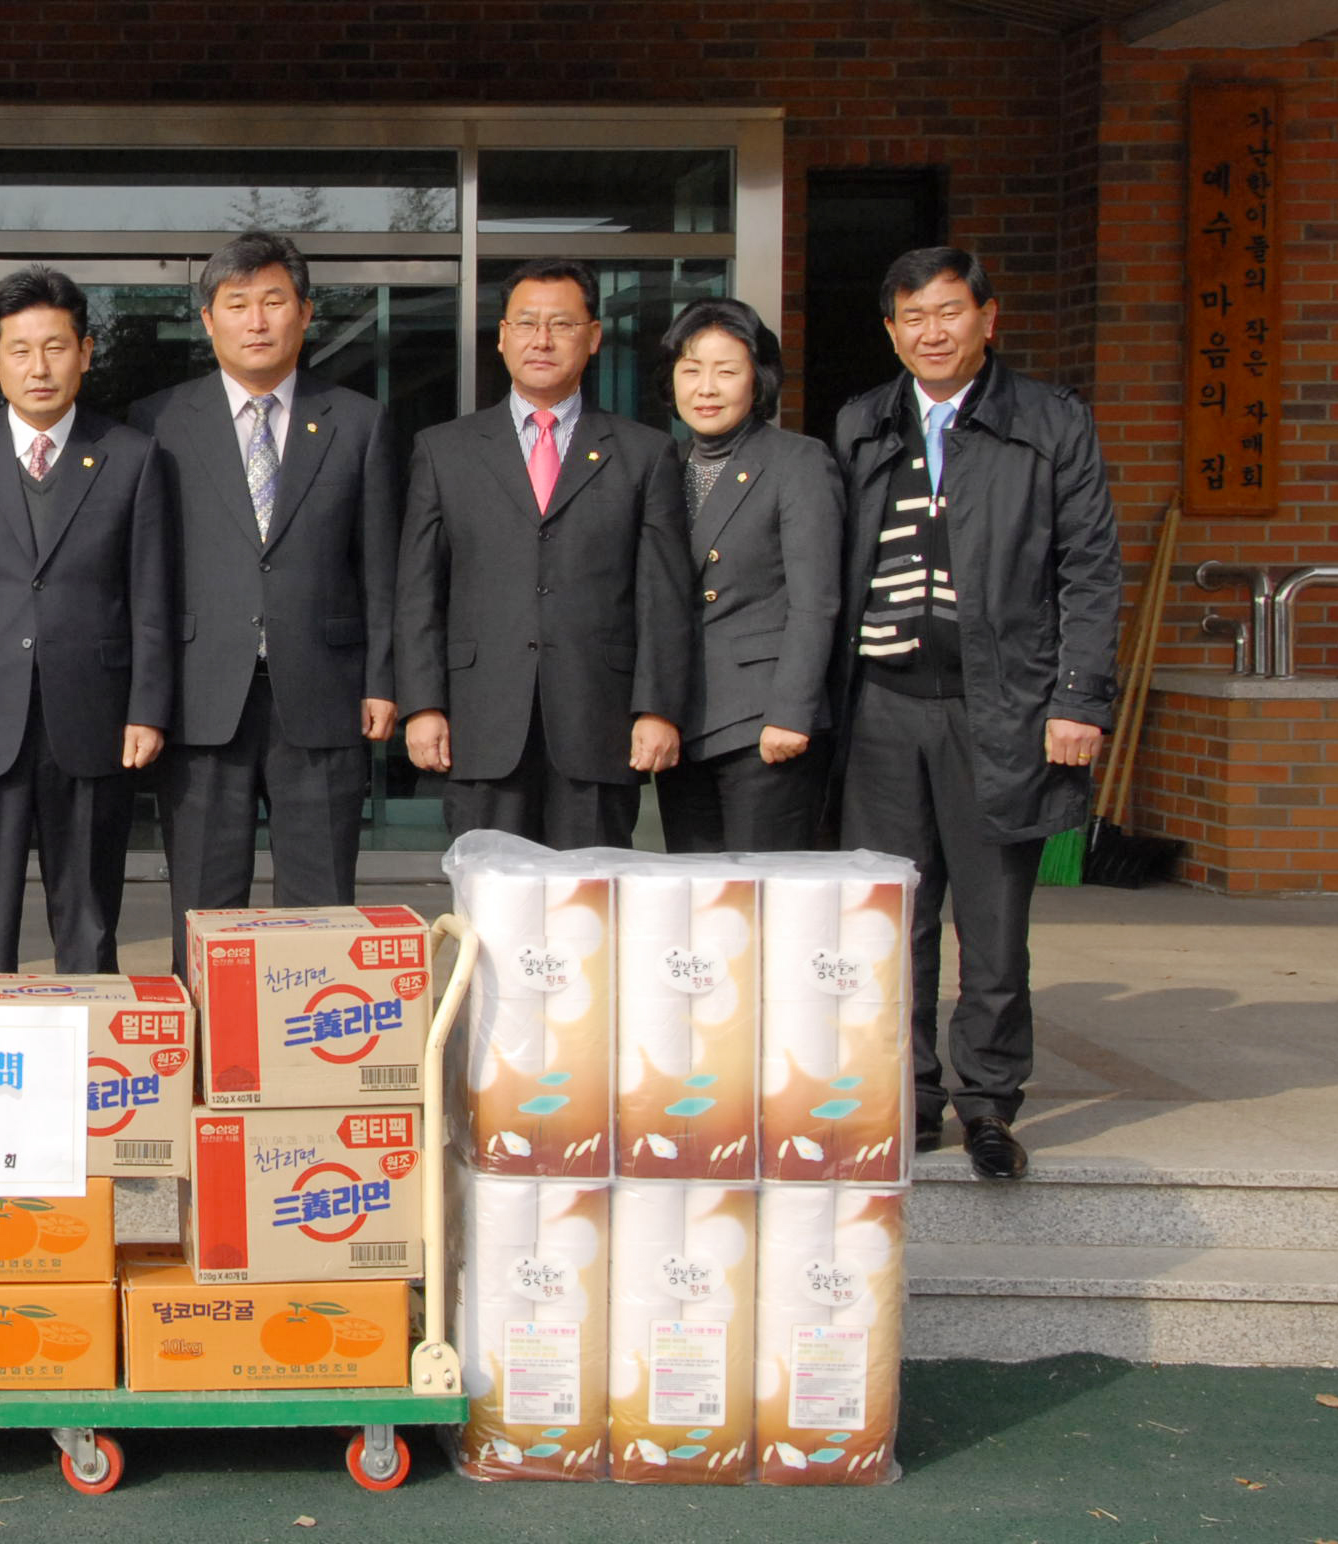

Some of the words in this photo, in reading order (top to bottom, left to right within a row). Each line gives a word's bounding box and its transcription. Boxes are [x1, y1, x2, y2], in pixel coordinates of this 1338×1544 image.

[1201, 162, 1233, 246] 예수
[1199, 283, 1233, 416] 마음의
[1243, 318, 1269, 377] 작은
[1239, 400, 1268, 489] 자매회
[1200, 454, 1225, 491] 집
[361, 937, 419, 965] 멀티팩
[264, 966, 335, 992] 친구라면
[398, 975, 422, 992] 원조
[122, 1015, 178, 1040] 멀티팩
[158, 1052, 182, 1067] 원조
[350, 1117, 408, 1144] 멀티팩
[254, 1146, 324, 1172] 친구라면
[386, 1154, 410, 1171] 원조
[153, 1300, 254, 1324] 달코미감귤
[160, 1338, 203, 1356] 10kg
